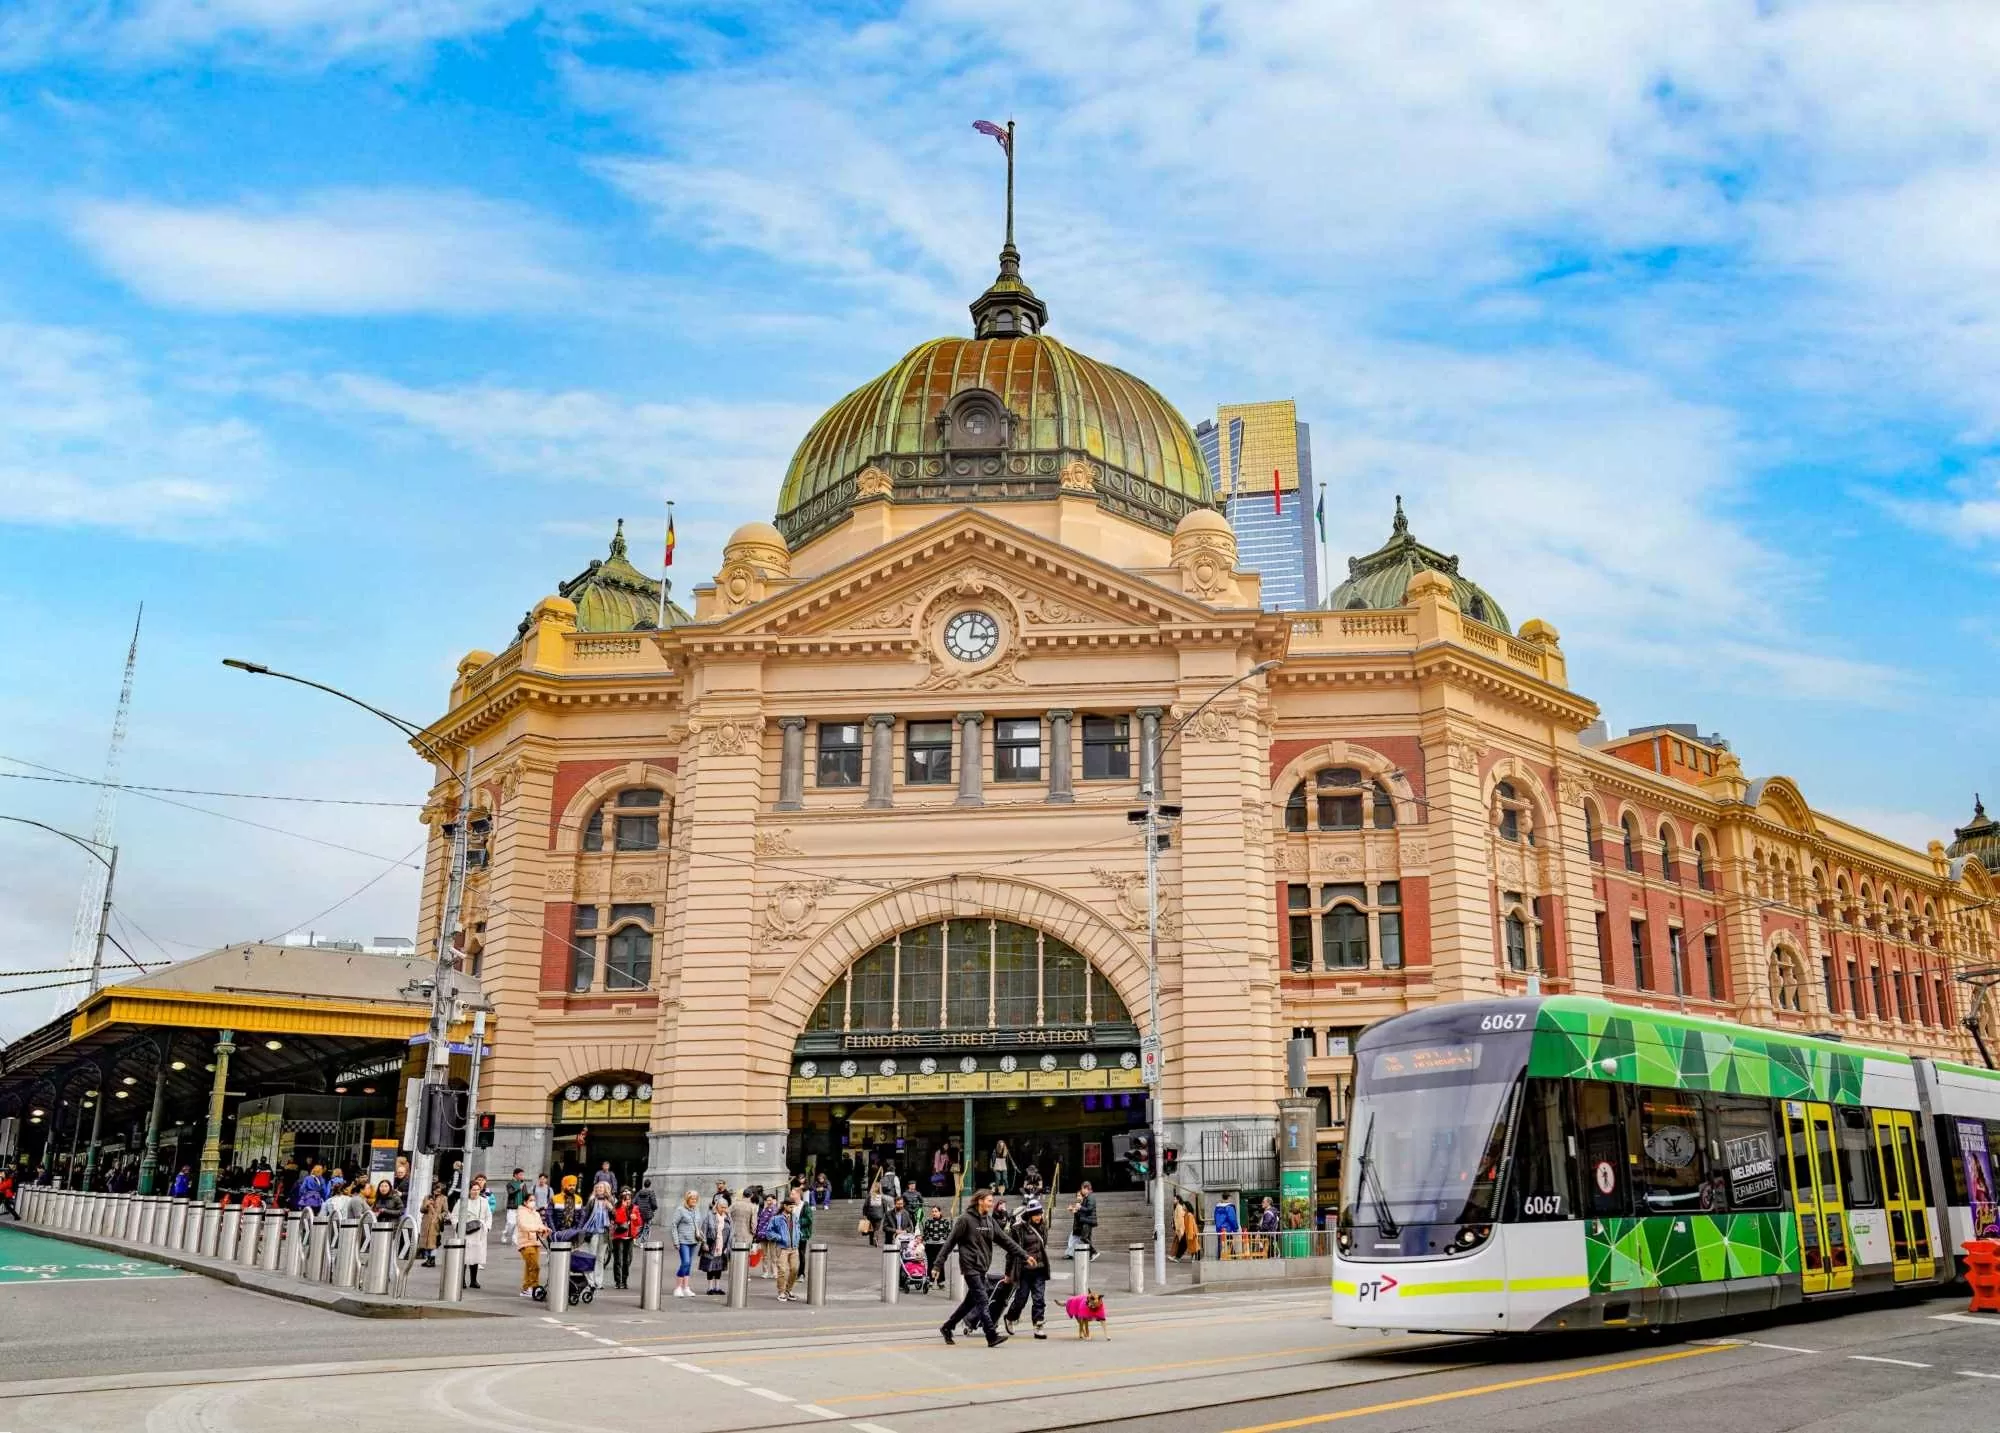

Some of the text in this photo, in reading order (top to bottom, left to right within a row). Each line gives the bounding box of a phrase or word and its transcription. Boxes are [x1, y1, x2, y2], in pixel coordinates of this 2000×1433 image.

[1481, 1014, 1527, 1030] 6067
[844, 1030, 1089, 1048] FLINDERS STREET STATION
[1728, 1138, 1760, 1166] MADE
[1732, 1159, 1773, 1180] MELBOURNE
[1524, 1196, 1561, 1215] 6067
